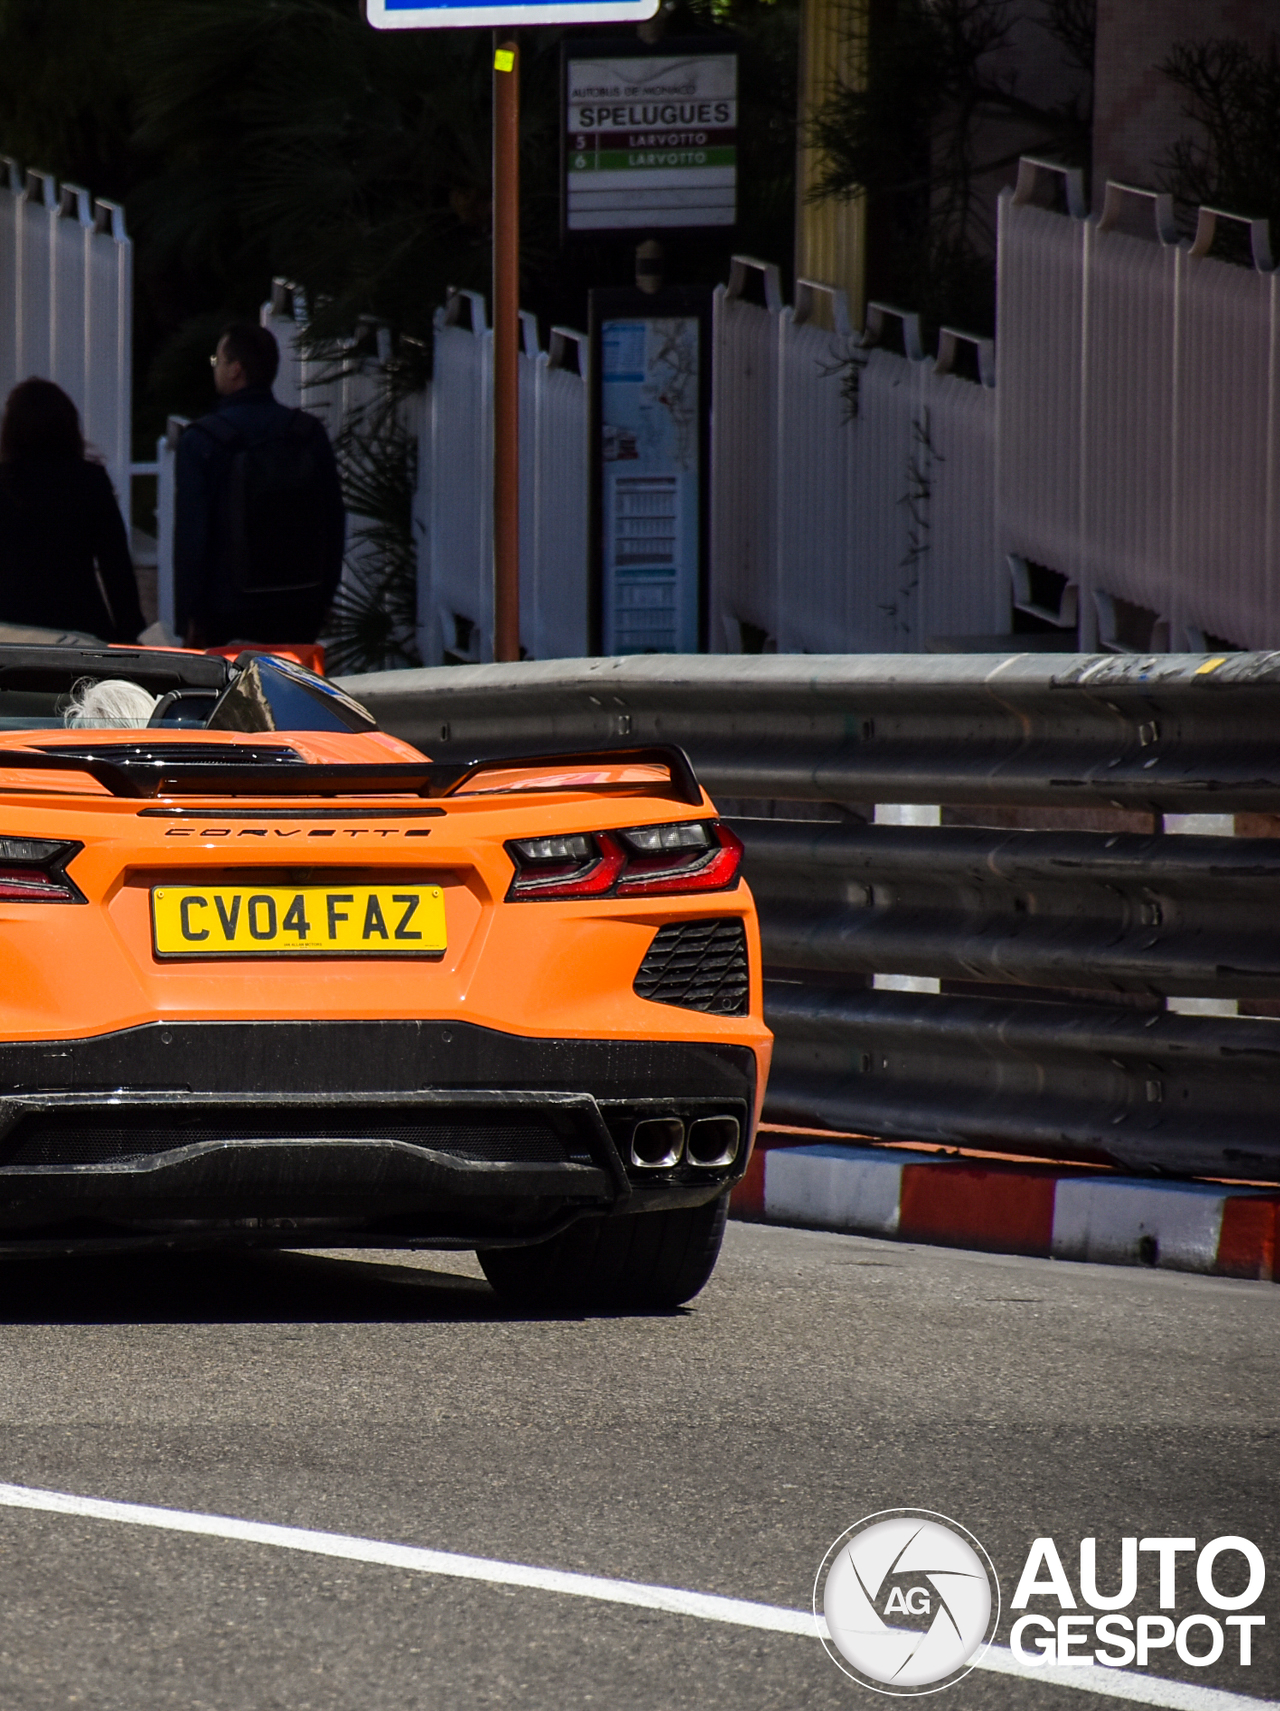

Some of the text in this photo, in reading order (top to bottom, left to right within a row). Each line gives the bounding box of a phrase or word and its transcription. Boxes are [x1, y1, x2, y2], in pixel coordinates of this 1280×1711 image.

[572, 84, 697, 98] AUTOBUS DE MONACO
[579, 103, 730, 128] SPELUGUES
[576, 133, 708, 150] 5 LARVOTTO
[575, 152, 707, 169] 6 LARVOTTO
[164, 828, 432, 837] CORVETTE
[180, 894, 423, 942] CV04 FAZ
